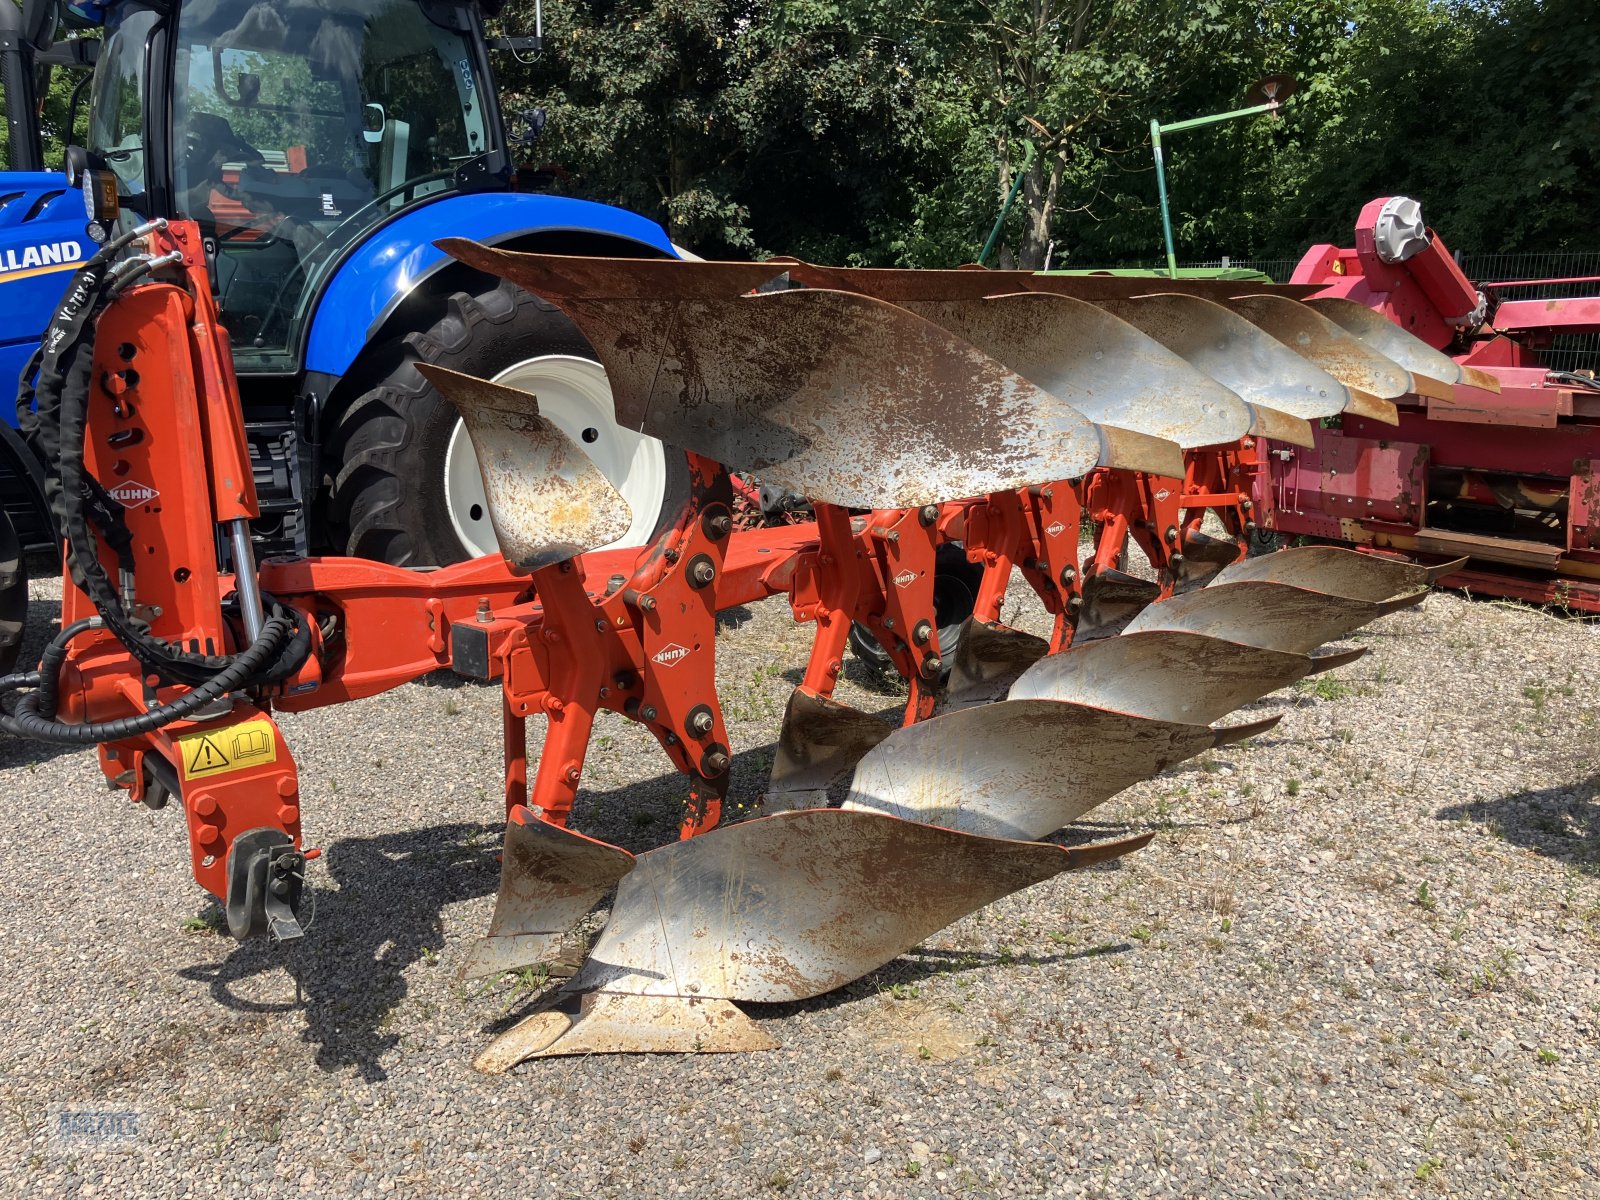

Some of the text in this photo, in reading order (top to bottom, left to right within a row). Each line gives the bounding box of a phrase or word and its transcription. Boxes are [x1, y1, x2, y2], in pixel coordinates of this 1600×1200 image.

[59, 271, 97, 321] VC-TEX-31
[109, 489, 152, 500] KUHN
[895, 572, 915, 585] KUHN
[657, 648, 685, 662] KUHN
